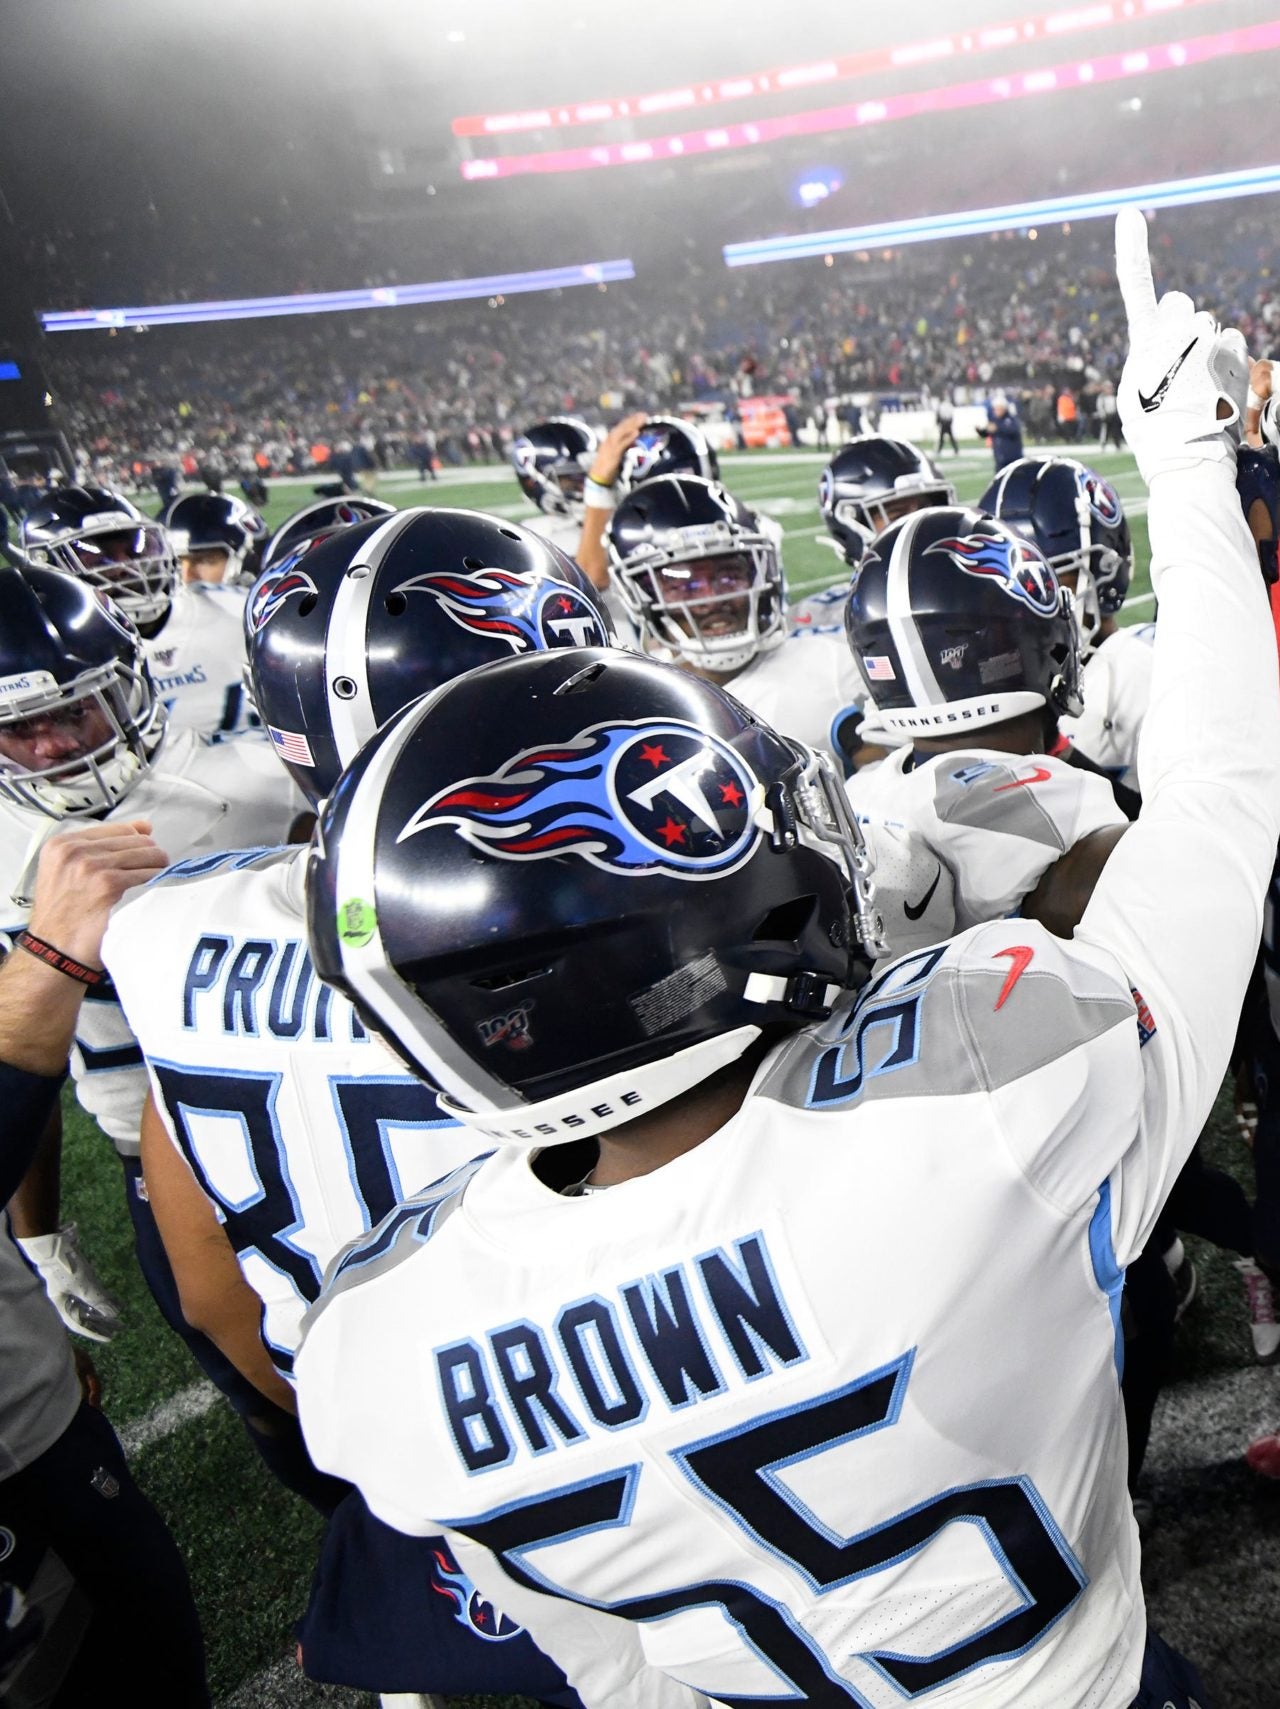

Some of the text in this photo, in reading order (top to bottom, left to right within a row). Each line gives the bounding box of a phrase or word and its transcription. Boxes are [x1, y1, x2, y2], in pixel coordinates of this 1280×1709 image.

[889, 704, 1000, 728] TENNESSEE
[431, 1229, 809, 1477] BROWN
[433, 1345, 1087, 1709] 55
